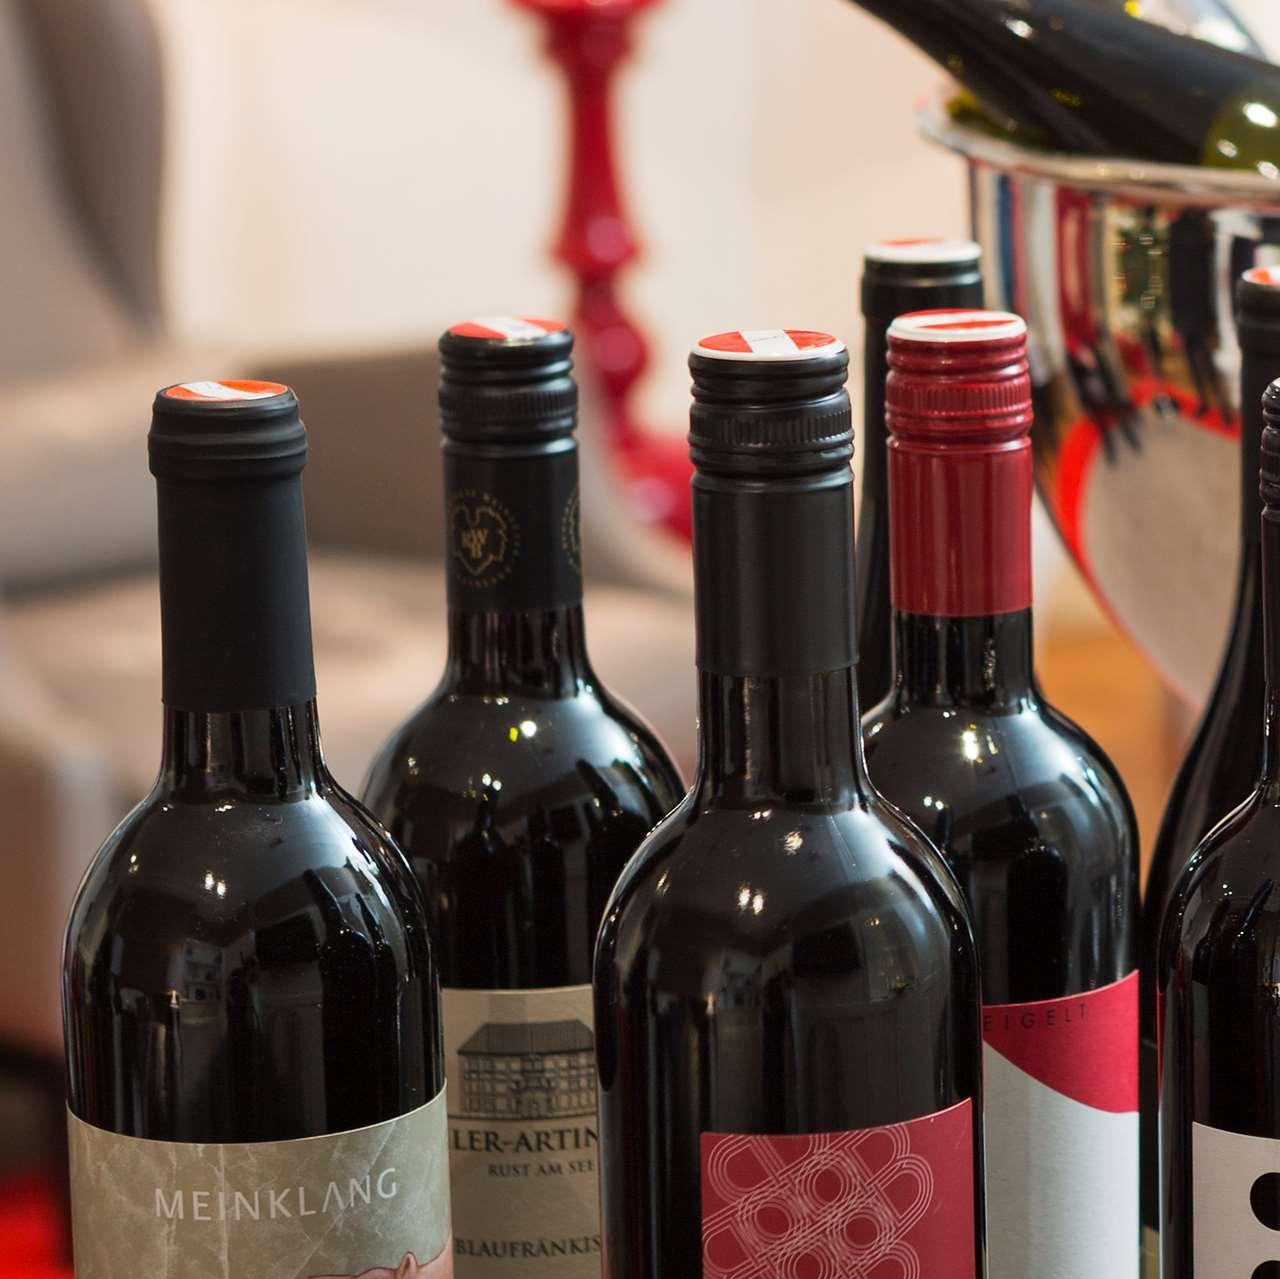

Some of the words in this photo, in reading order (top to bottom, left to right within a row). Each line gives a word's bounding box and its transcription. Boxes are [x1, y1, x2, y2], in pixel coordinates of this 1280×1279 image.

[488, 1163, 531, 1177] RUST
[536, 1162, 563, 1177] AM
[155, 1167, 397, 1222] MEINKLANG
